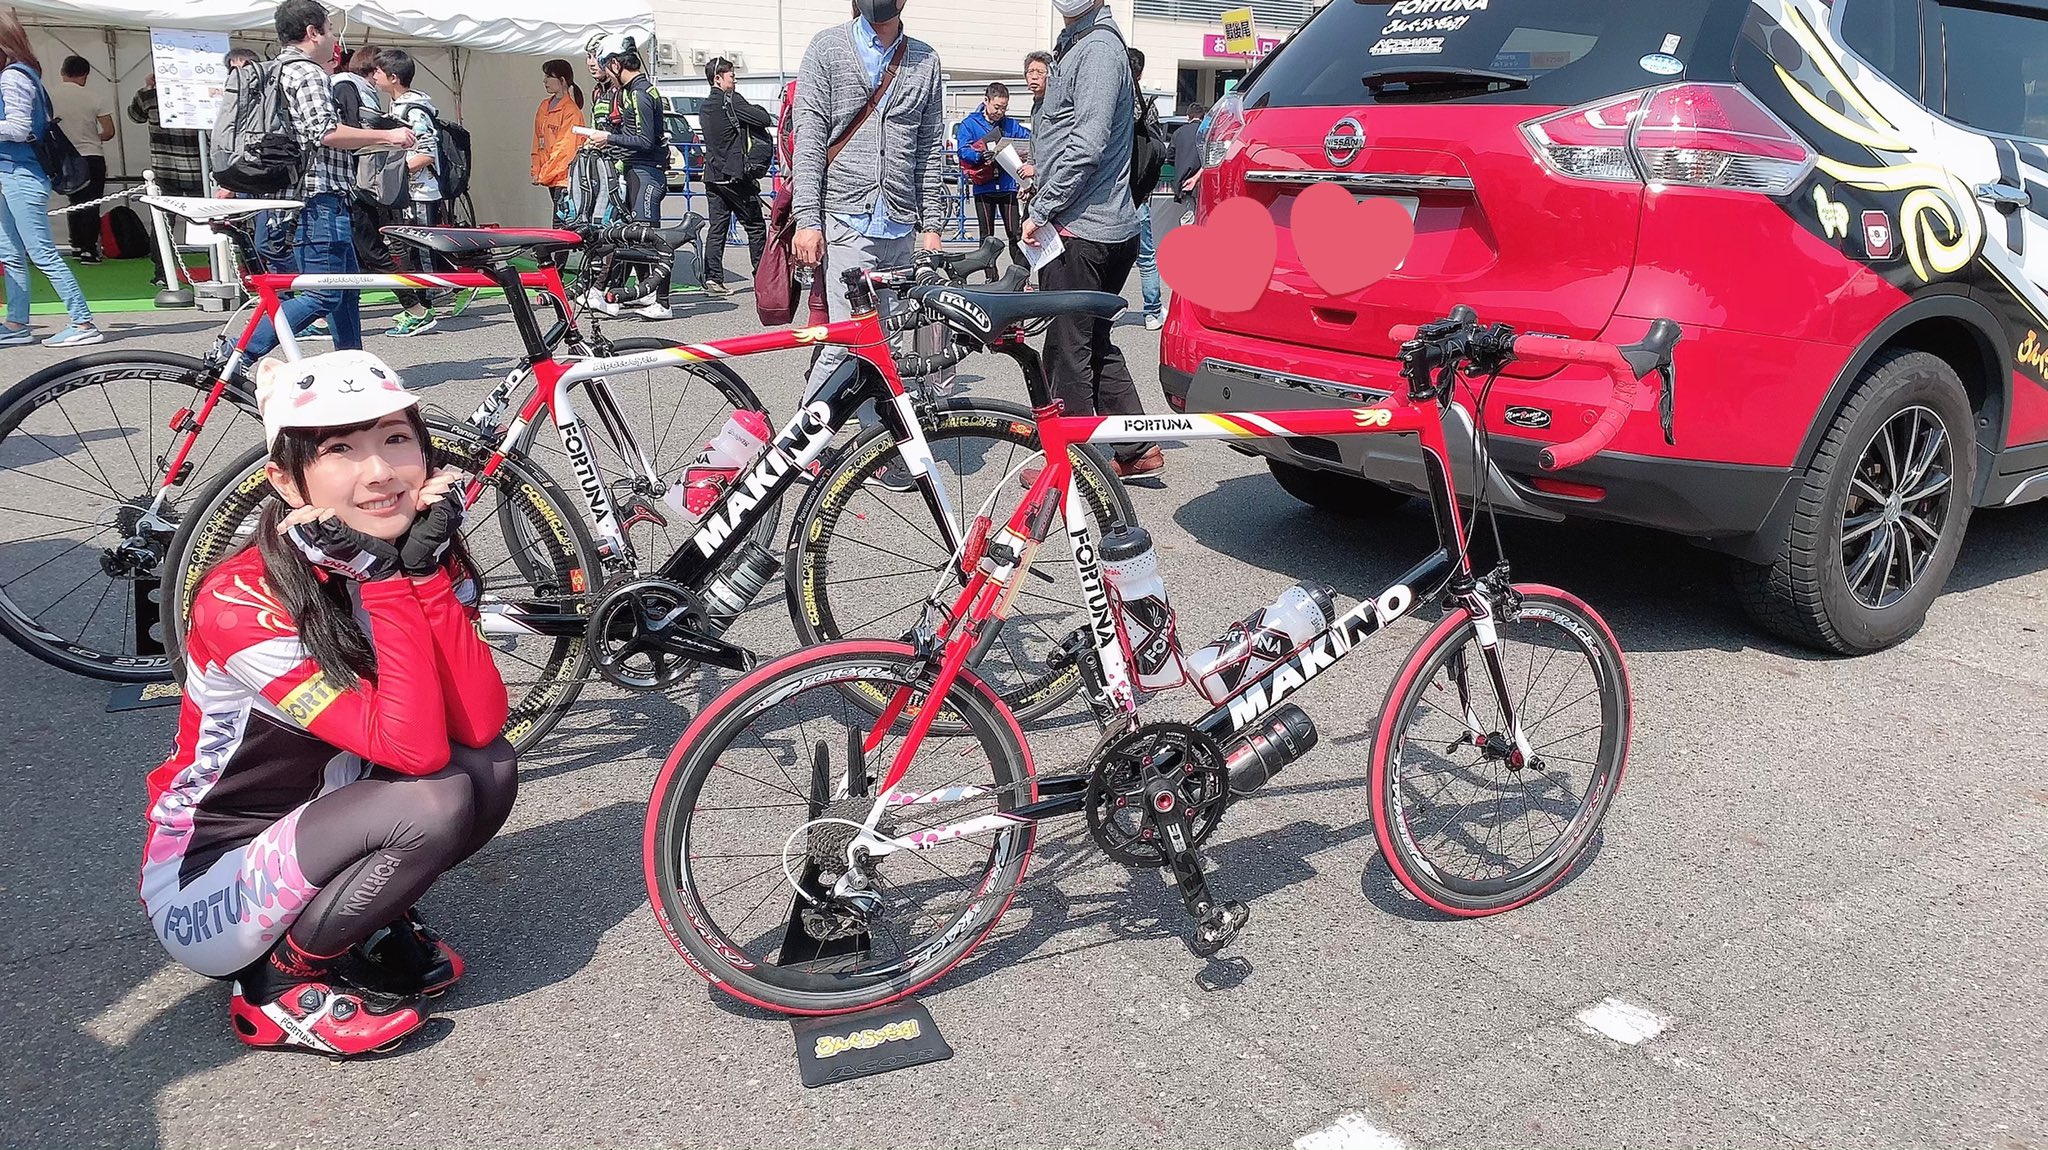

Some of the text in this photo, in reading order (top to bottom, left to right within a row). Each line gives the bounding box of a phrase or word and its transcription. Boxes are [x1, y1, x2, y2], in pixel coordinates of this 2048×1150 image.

[1225, 20, 1251, 40] 最後尾
[1326, 138, 1359, 147] NISSAN
[939, 291, 987, 327] ITALIA
[33, 368, 182, 408] DURA-ACE
[1124, 418, 1193, 432] FORTUNA
[558, 421, 610, 524] FORTUNA
[693, 400, 831, 559] MAKINO
[1070, 527, 1116, 649] FORTUNA
[1227, 584, 1413, 731] MAKINO
[338, 853, 402, 917] FORTUNA
[163, 866, 280, 946] FORTUNA
[280, 1016, 316, 1047] FORTUNA
[826, 1049, 934, 1080] ACOR
